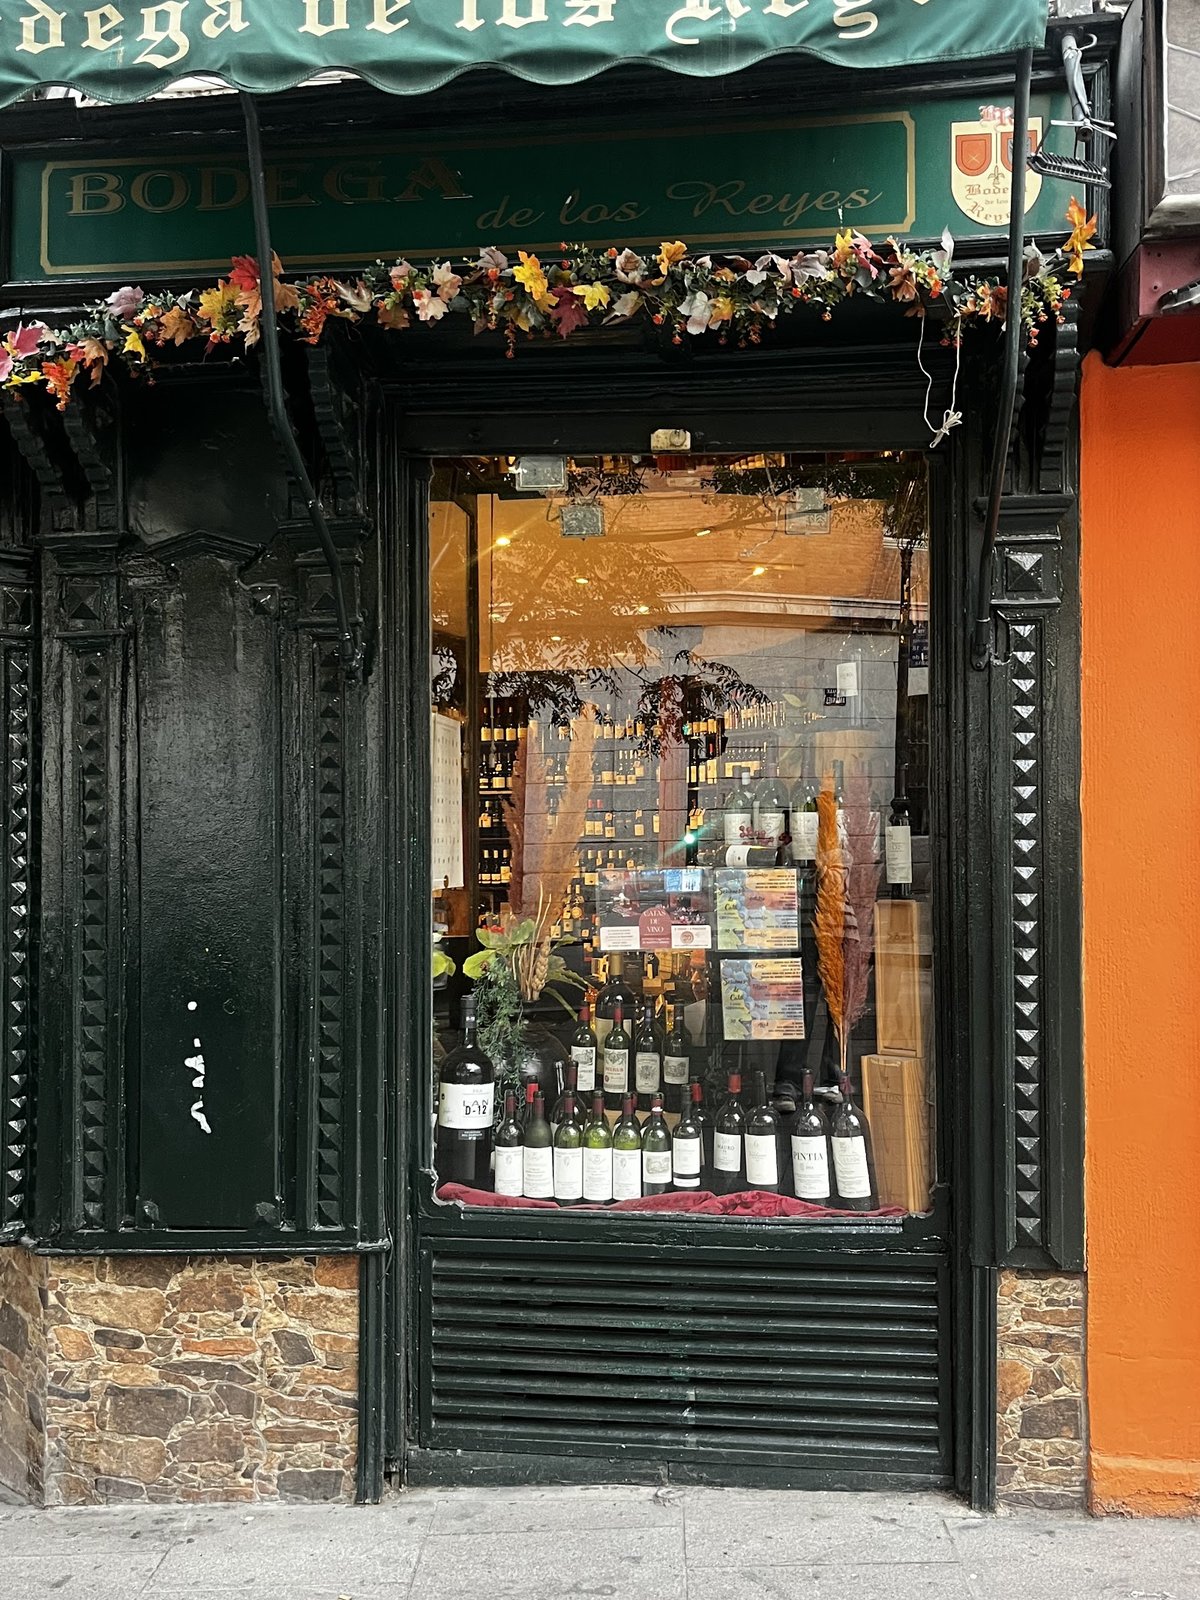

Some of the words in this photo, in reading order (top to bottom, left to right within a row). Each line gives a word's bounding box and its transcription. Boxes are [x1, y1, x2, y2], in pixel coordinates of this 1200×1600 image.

[0, 0, 251, 69] dega
[63, 155, 475, 217] BODEGA
[475, 194, 545, 230] de
[558, 184, 650, 226] los
[665, 180, 887, 227] Reyes
[965, 183, 1028, 200] Bode
[465, 1105, 487, 1115] D-12
[793, 1152, 824, 1161] PINTIA
